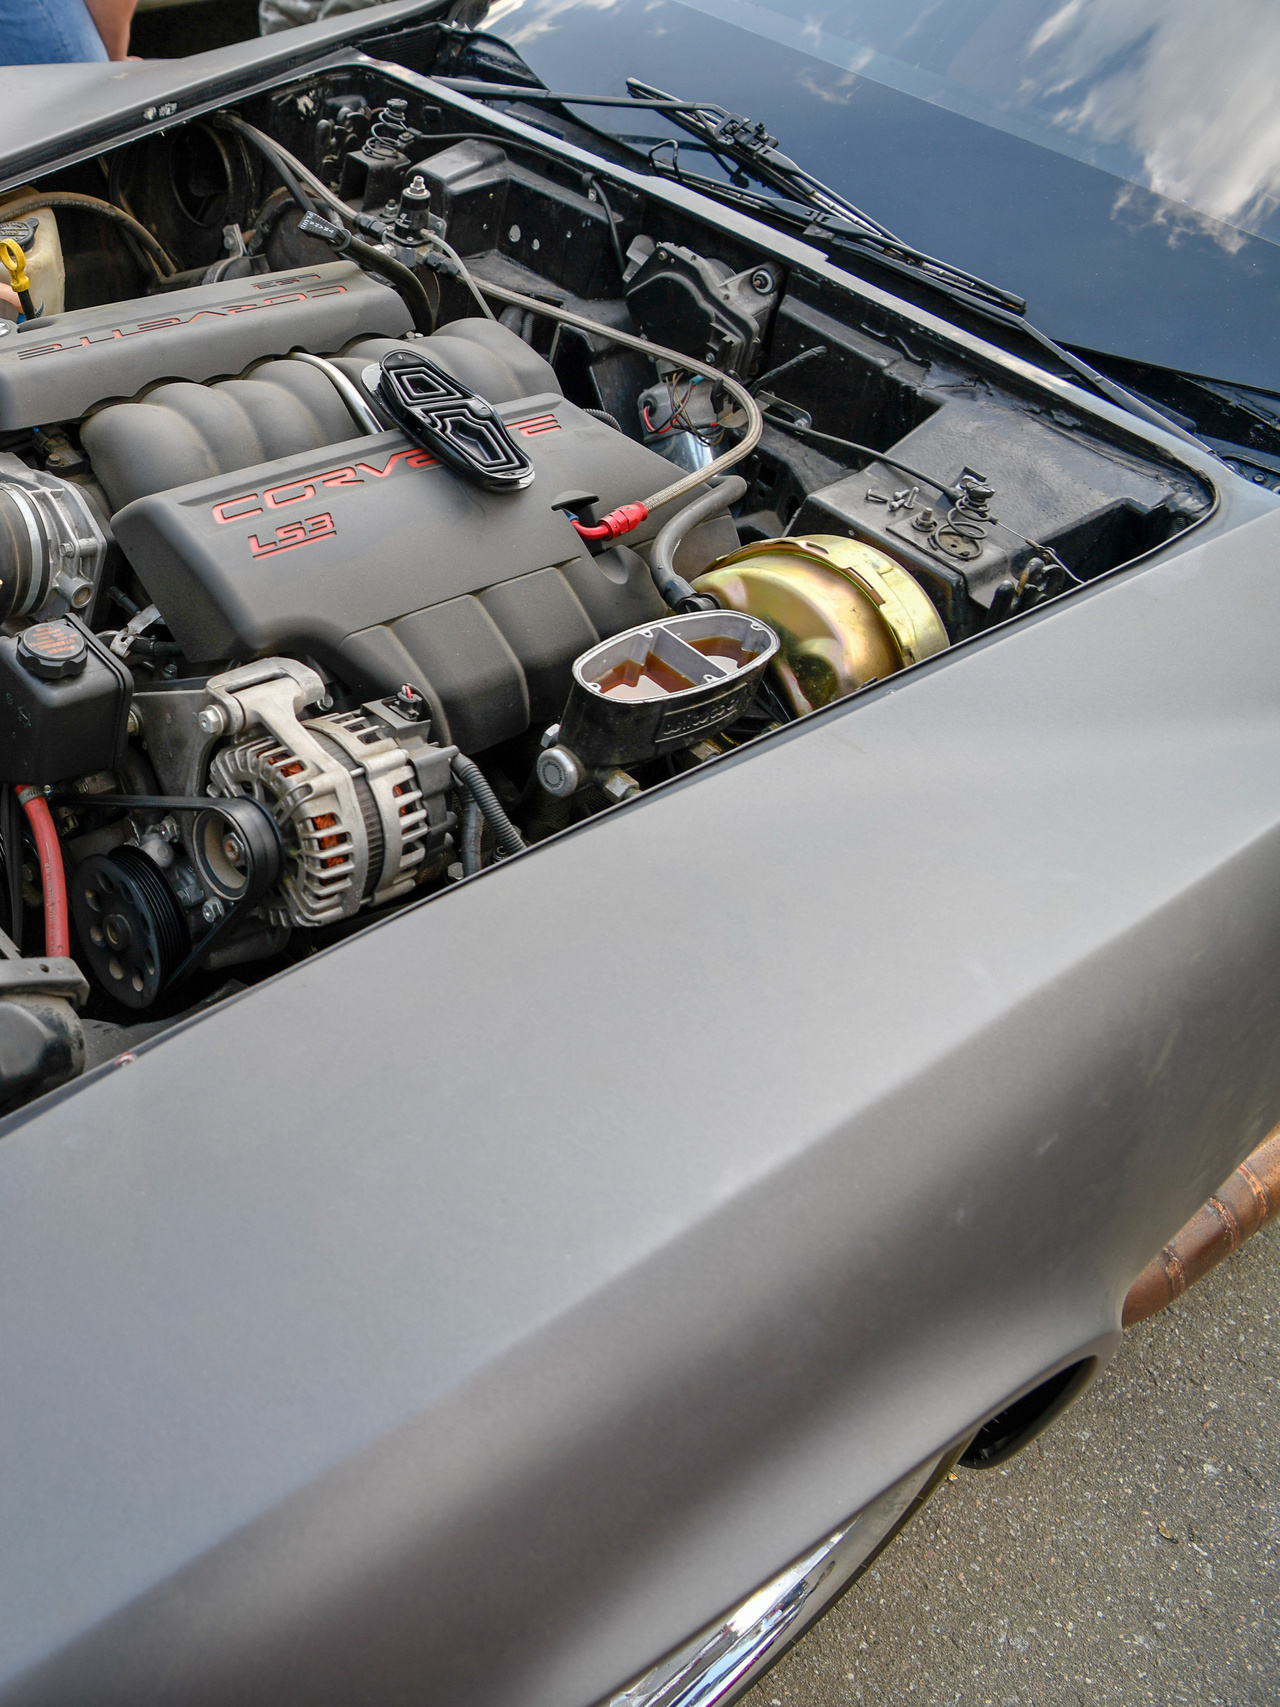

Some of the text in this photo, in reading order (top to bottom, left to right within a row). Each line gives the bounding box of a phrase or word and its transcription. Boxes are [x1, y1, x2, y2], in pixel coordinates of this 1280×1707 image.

[17, 284, 349, 361] CORVETTE
[212, 414, 563, 525] CORVEE
[248, 512, 336, 555] LS3
